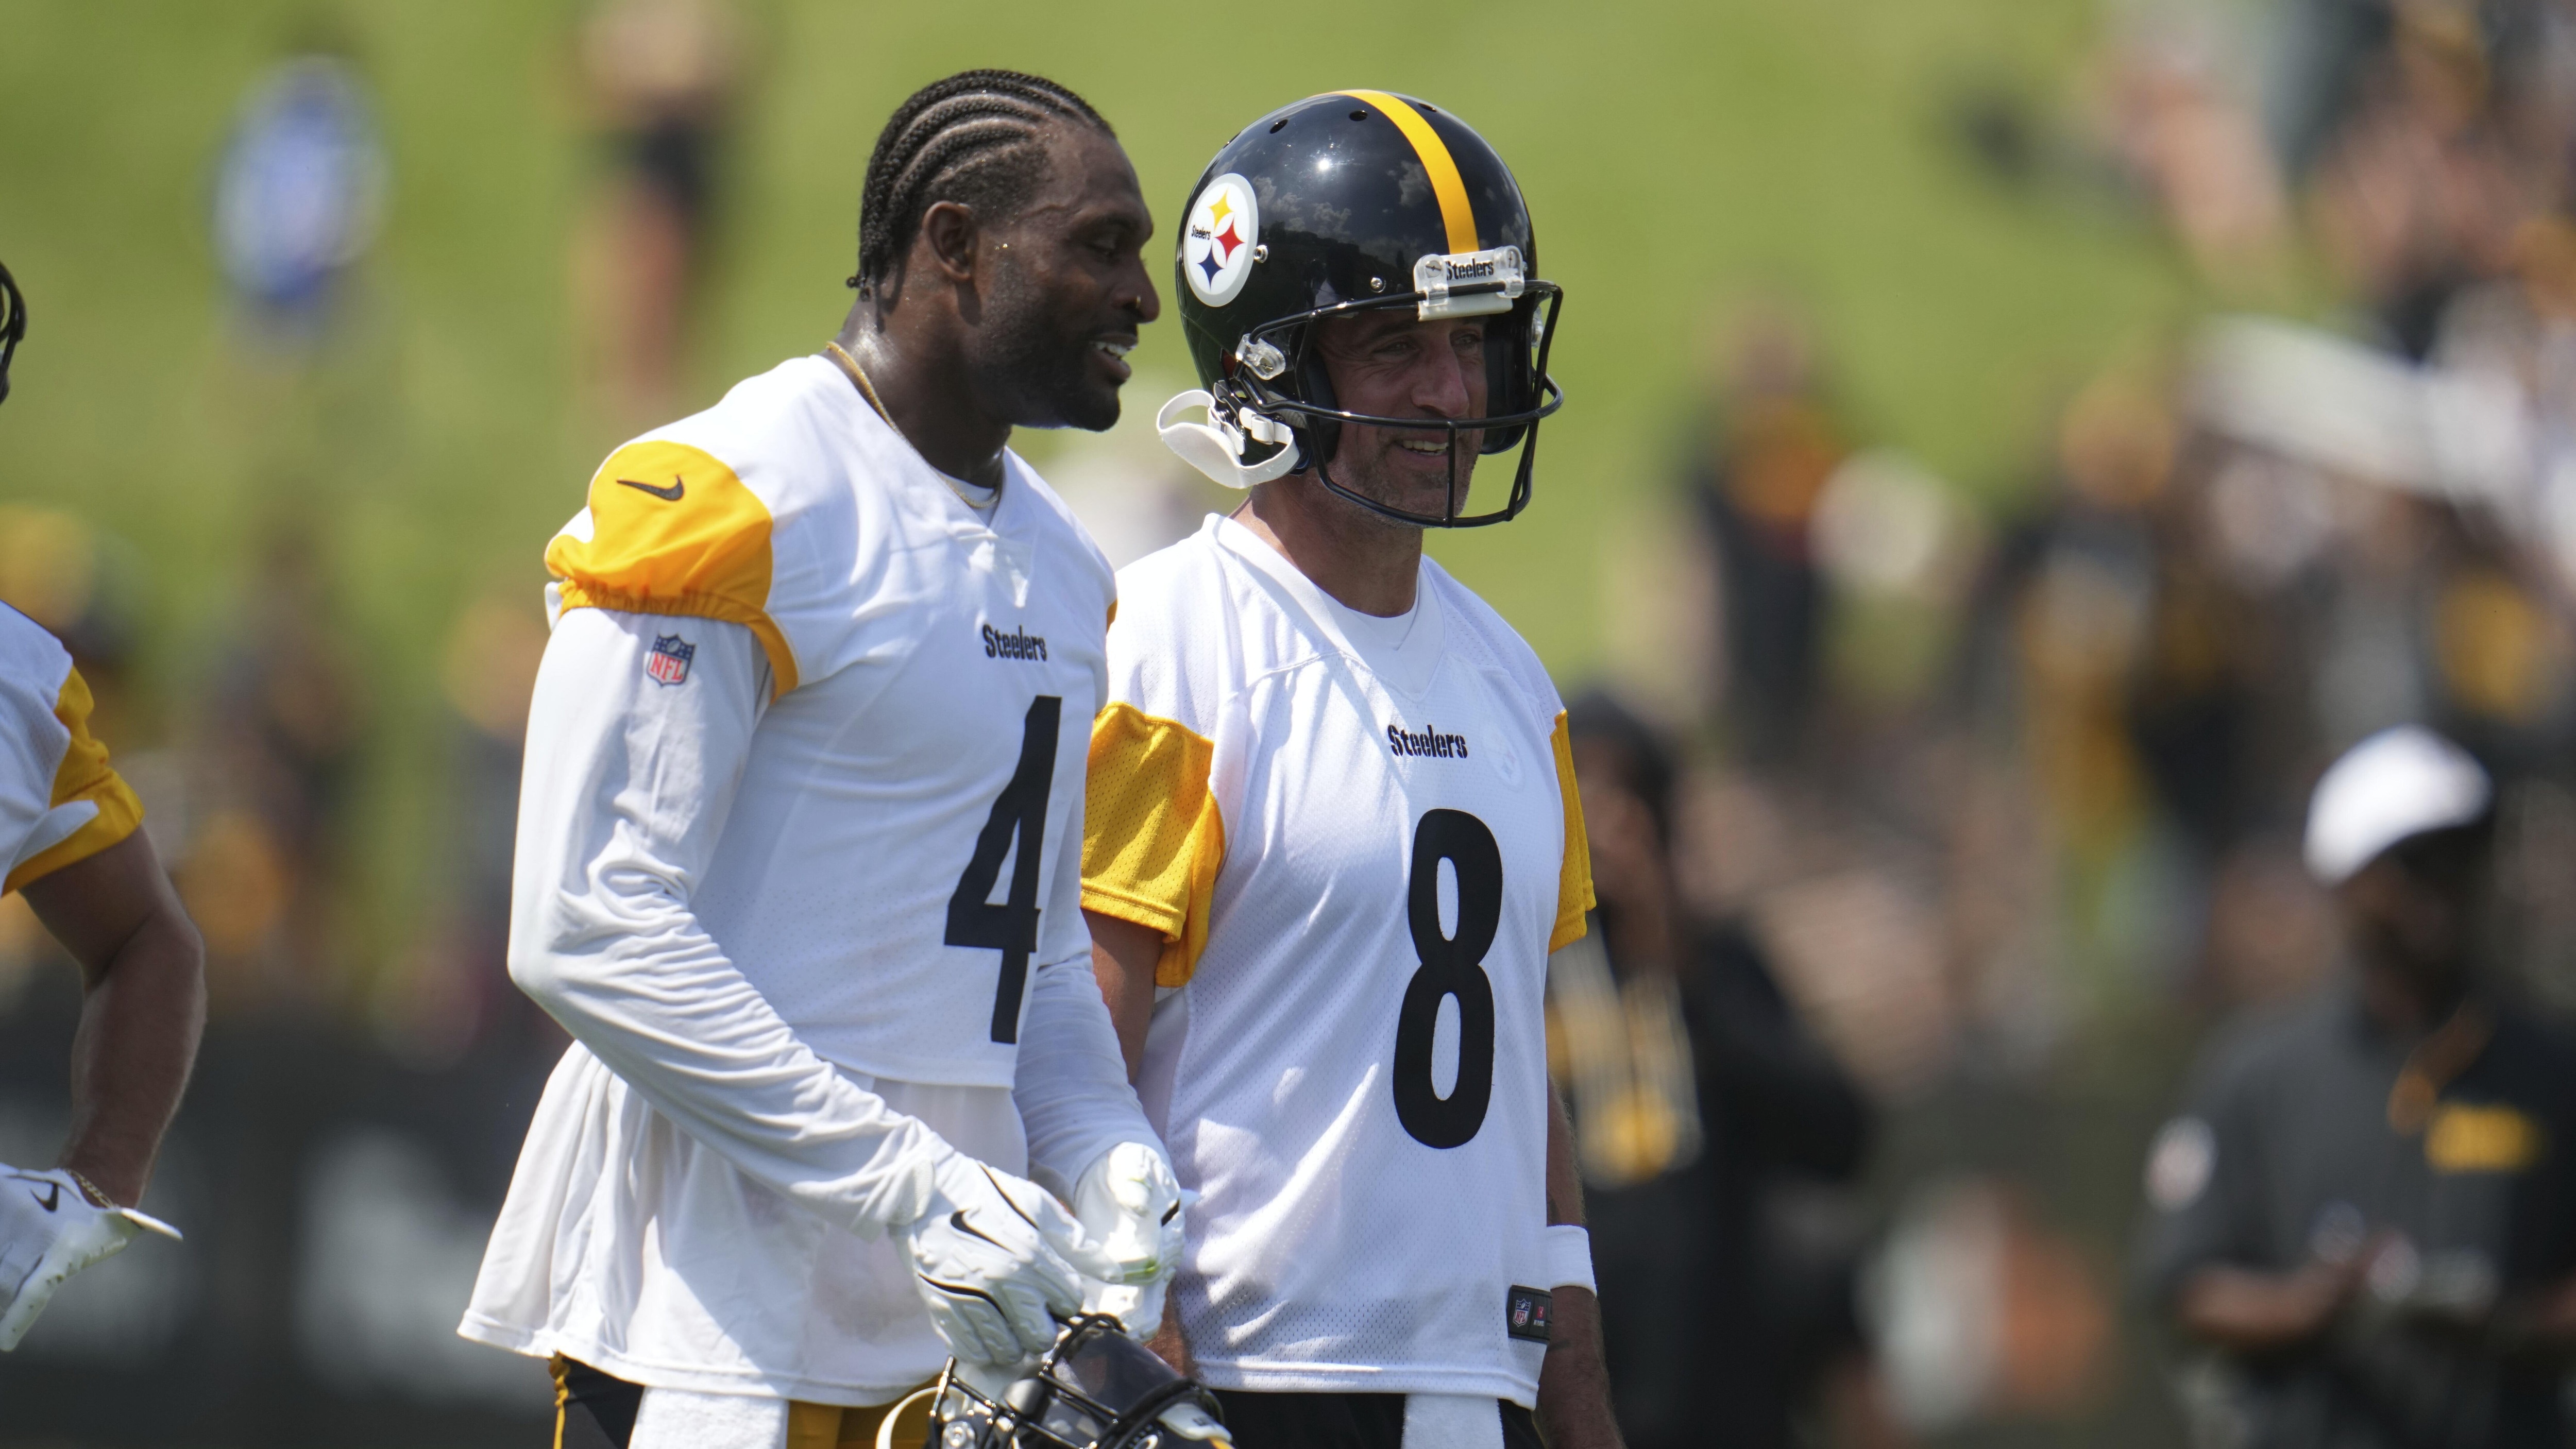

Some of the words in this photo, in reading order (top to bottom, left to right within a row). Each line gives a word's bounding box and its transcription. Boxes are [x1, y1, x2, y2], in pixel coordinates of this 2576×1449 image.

[1191, 225, 1211, 240] Steelers
[1444, 258, 1494, 281] Steelers
[982, 624, 1047, 661] Steelers
[650, 652, 683, 680] NFL
[1387, 724, 1468, 759] Steelers
[944, 695, 1062, 1044] 4
[1393, 808, 1503, 1149] 8
[1515, 1310, 1526, 1323] NFL
